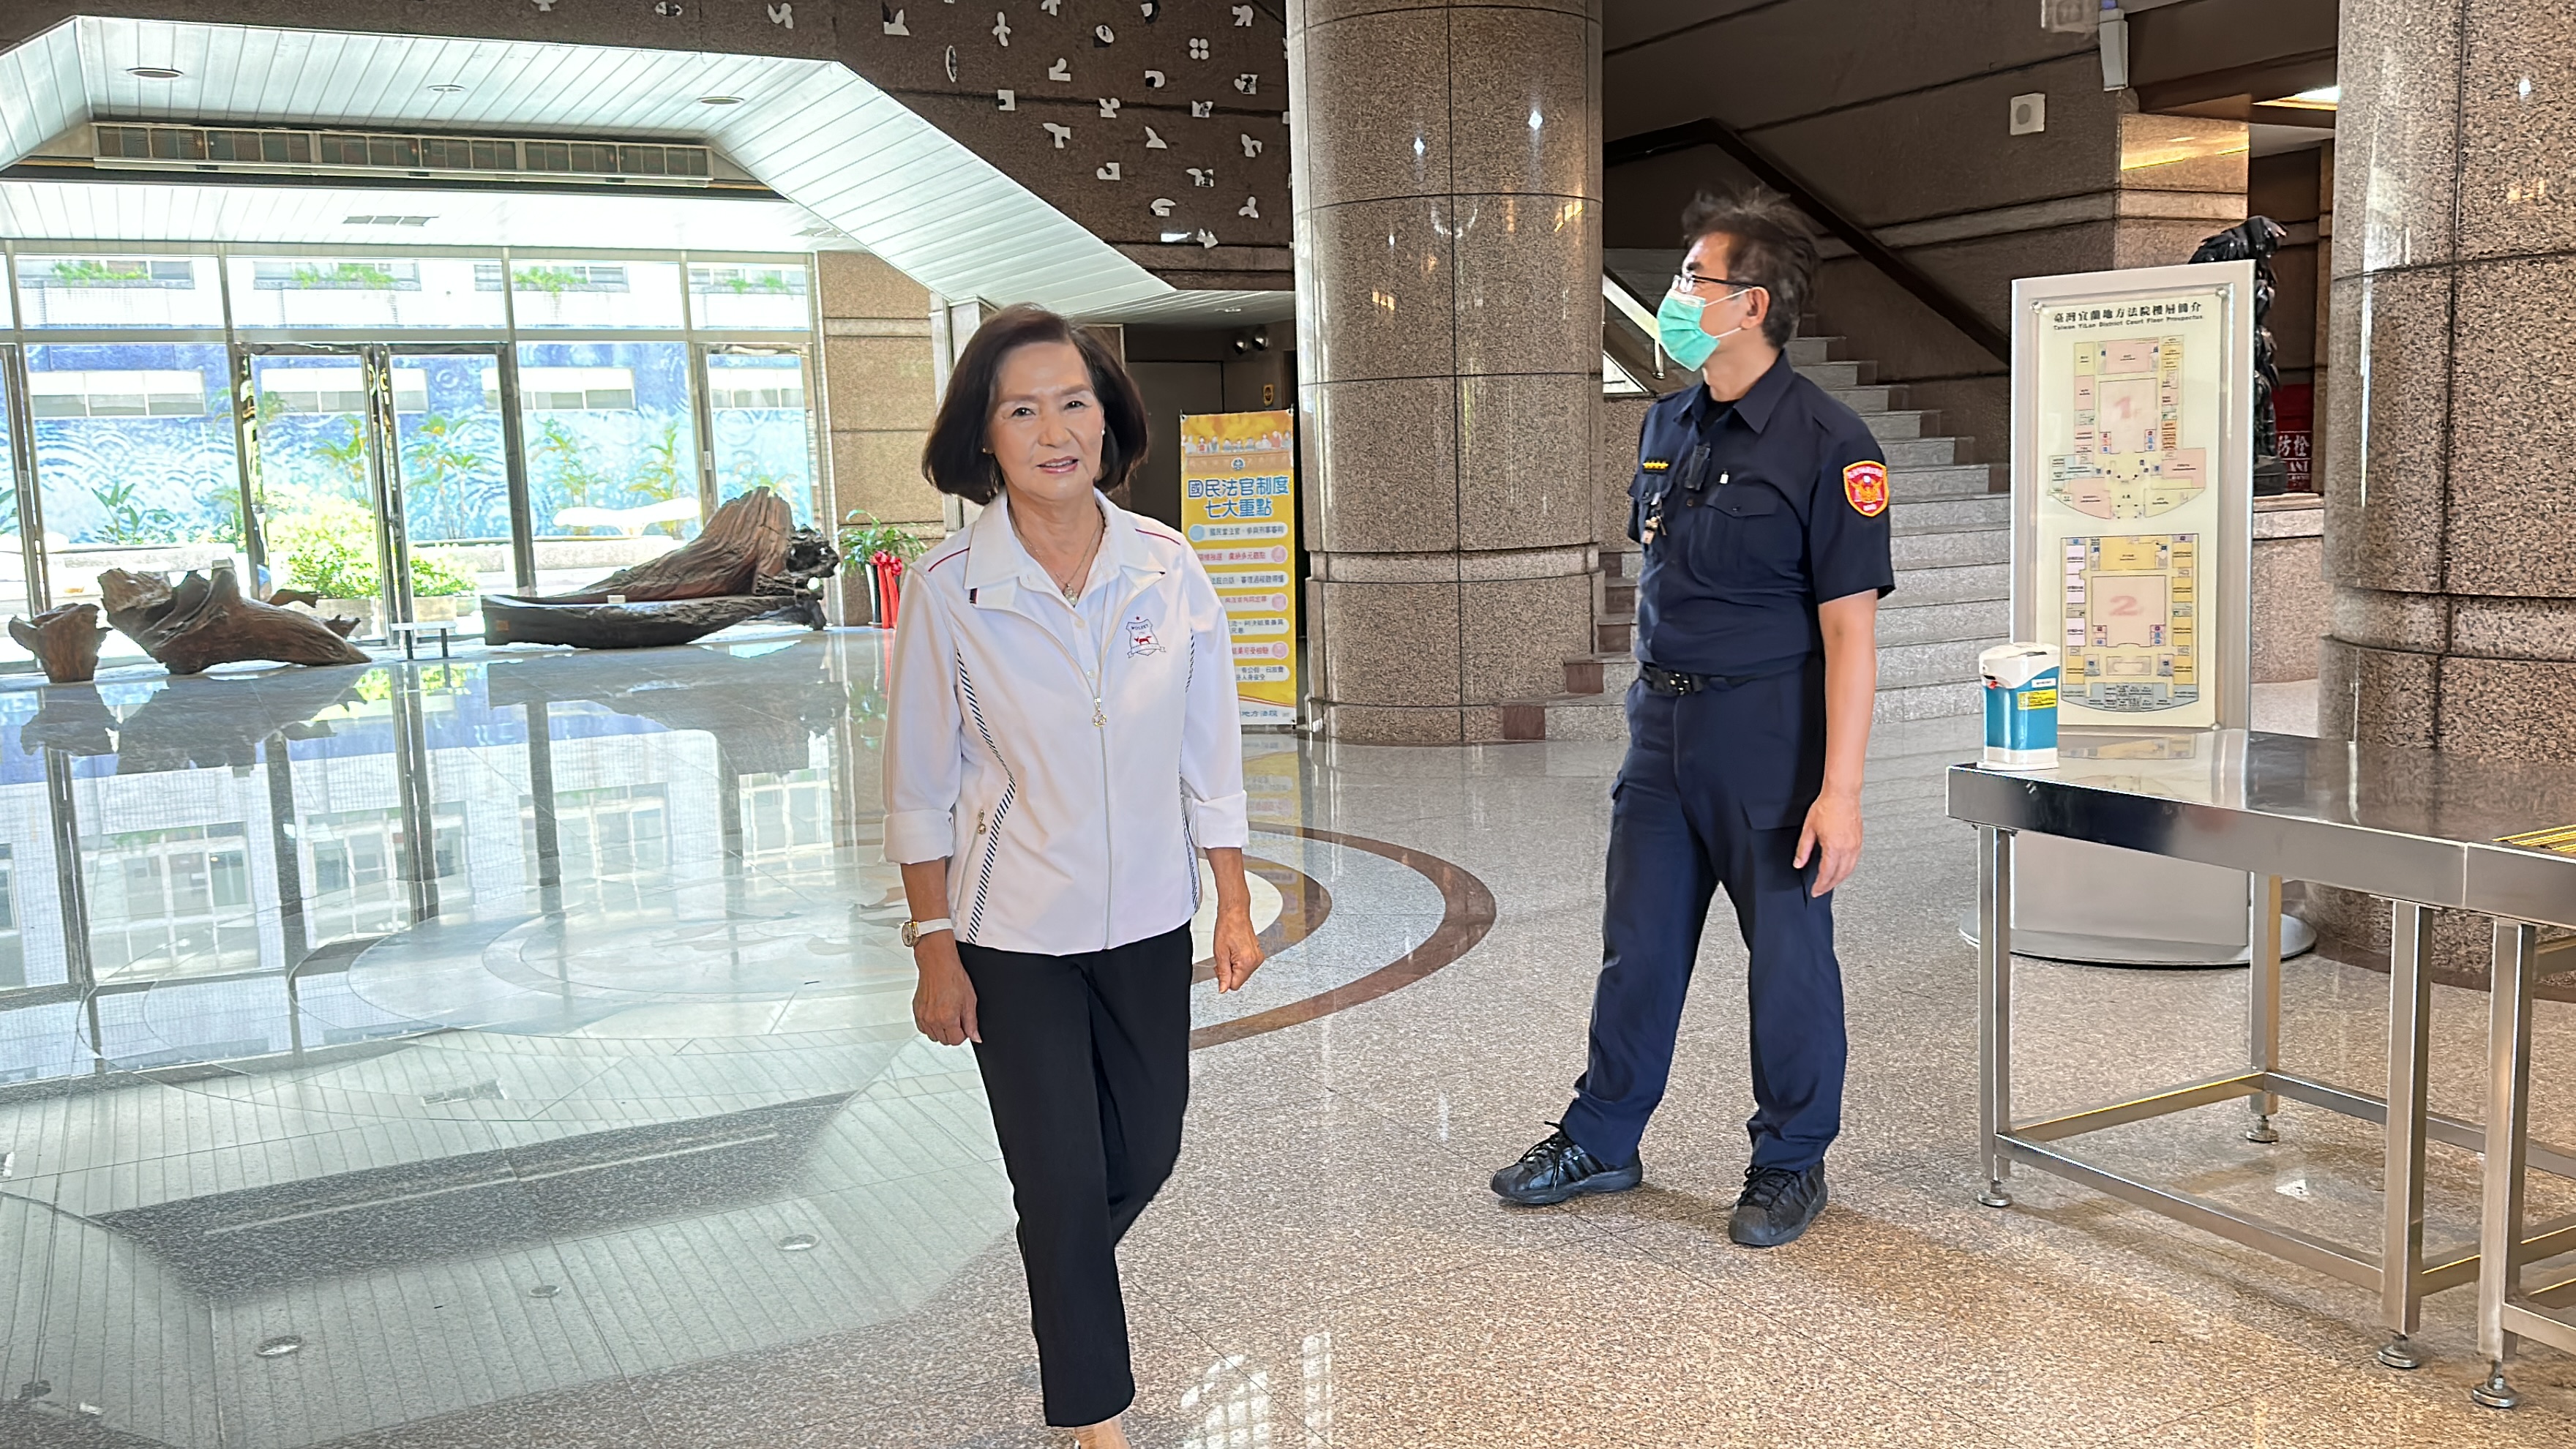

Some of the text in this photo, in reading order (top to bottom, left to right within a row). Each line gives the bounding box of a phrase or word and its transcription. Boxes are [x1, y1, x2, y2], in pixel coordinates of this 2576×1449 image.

[2053, 302, 2201, 323] 臺灣宜蘭地方法院樓層簡介
[1187, 476, 1289, 498] 國民法官制度
[1205, 497, 1273, 520] 七大重點
